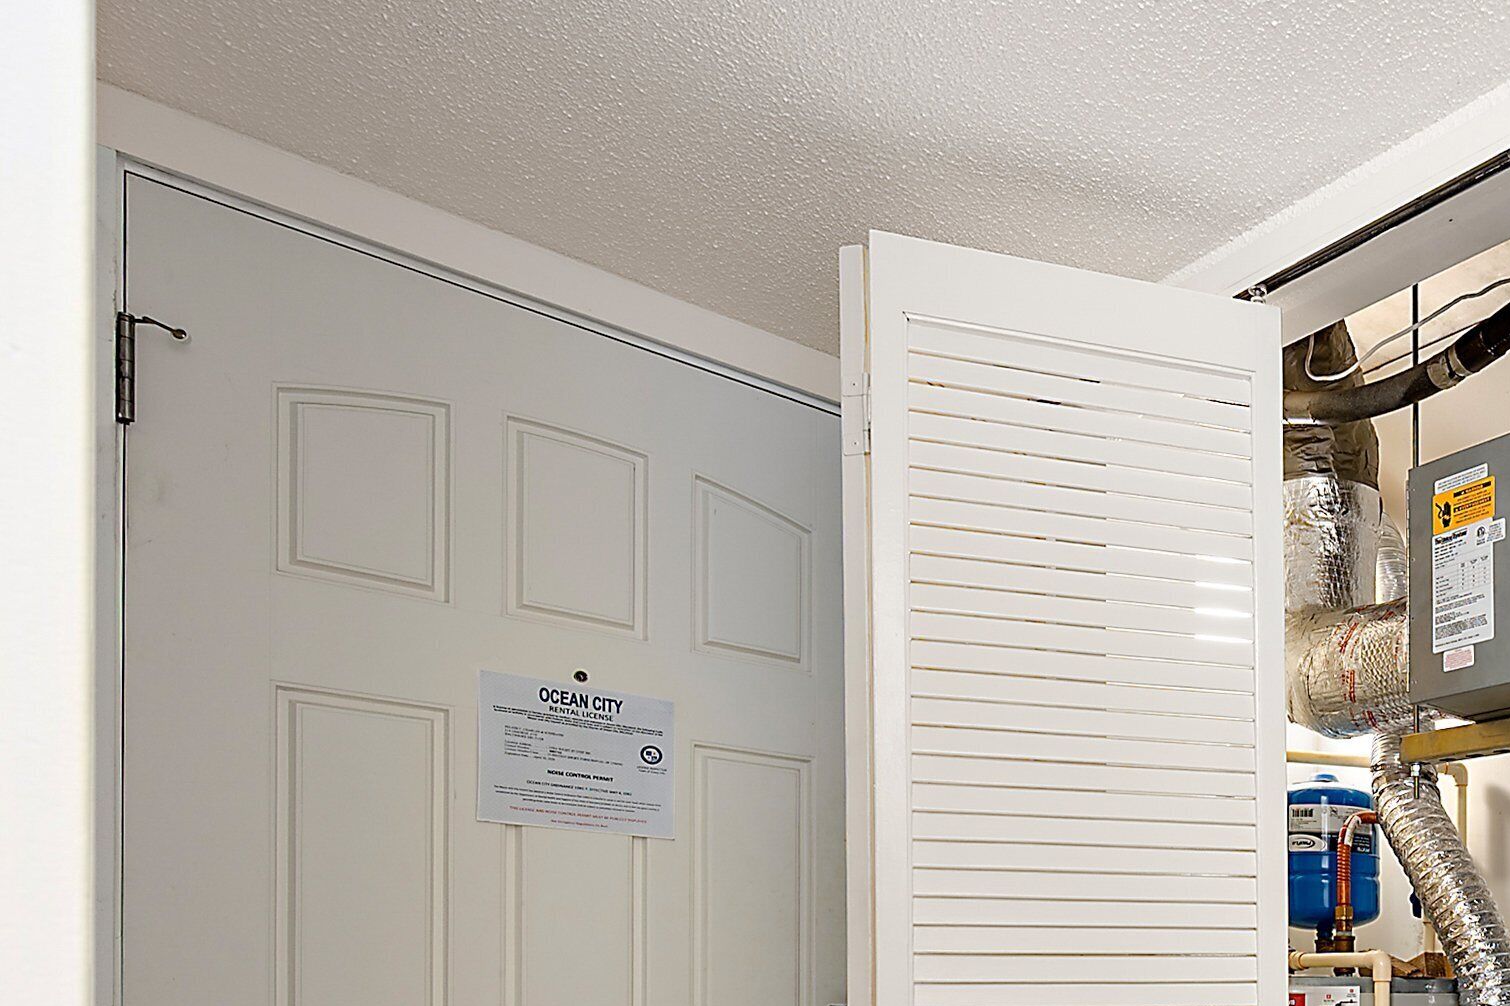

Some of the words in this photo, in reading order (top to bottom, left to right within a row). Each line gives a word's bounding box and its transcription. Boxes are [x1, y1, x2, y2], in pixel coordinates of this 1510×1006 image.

[539, 687, 589, 709] OCEAN
[593, 696, 623, 714] CITY
[549, 706, 580, 717] RENTAL
[583, 712, 613, 722] LICENSE
[566, 772, 592, 780] CONTROL
